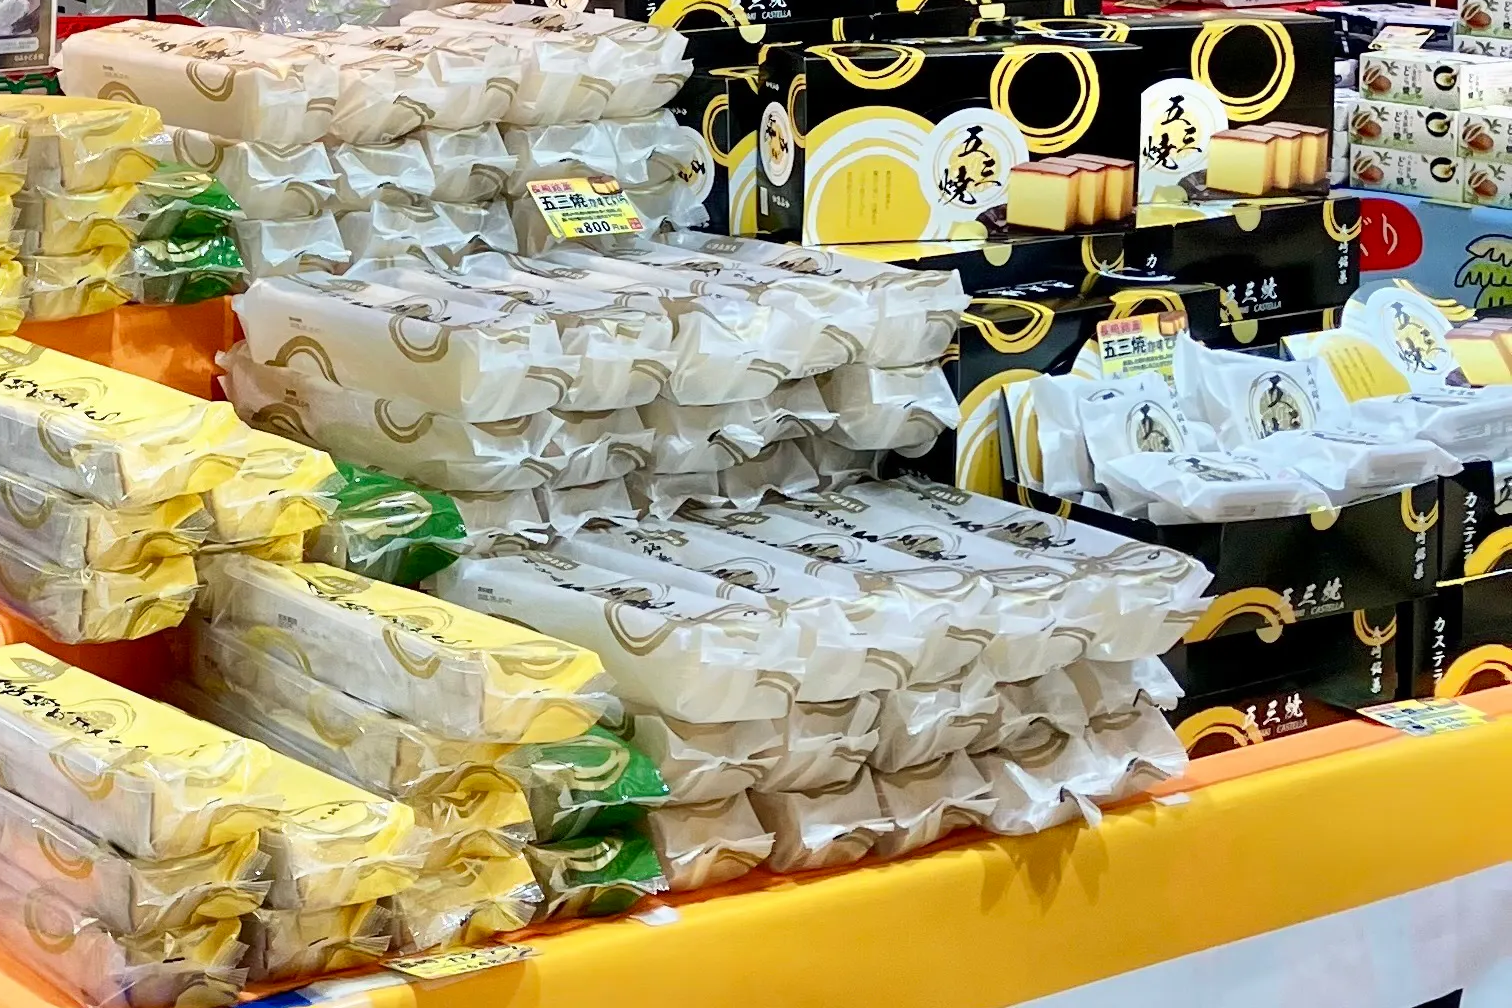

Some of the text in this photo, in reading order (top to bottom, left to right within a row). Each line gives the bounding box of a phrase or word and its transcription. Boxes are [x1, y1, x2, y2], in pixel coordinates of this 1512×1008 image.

[938, 124, 1002, 206] 五三焼
[1142, 94, 1202, 170] 五三焼
